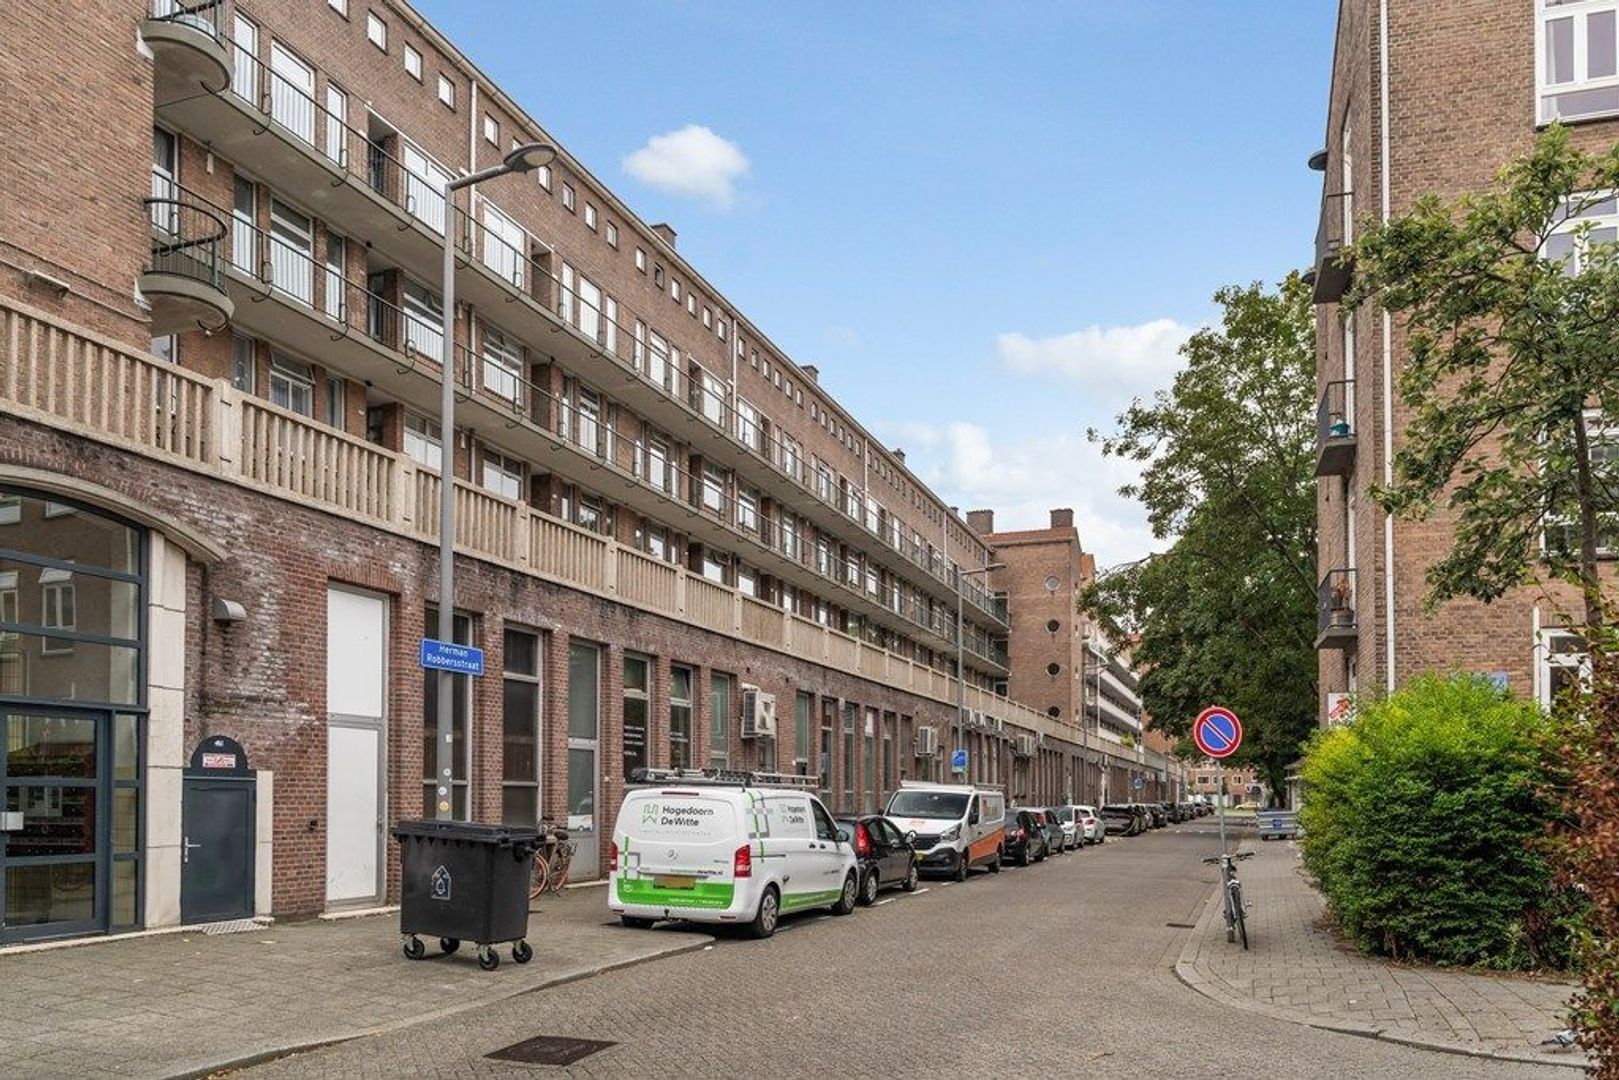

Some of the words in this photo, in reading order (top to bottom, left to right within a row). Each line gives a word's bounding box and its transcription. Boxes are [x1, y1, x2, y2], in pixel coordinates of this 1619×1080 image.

[439, 645, 468, 657] Herman
[426, 653, 479, 670] Robbersstraat
[662, 806, 714, 816] Hogedoorn
[661, 816, 700, 826] DeWitte
